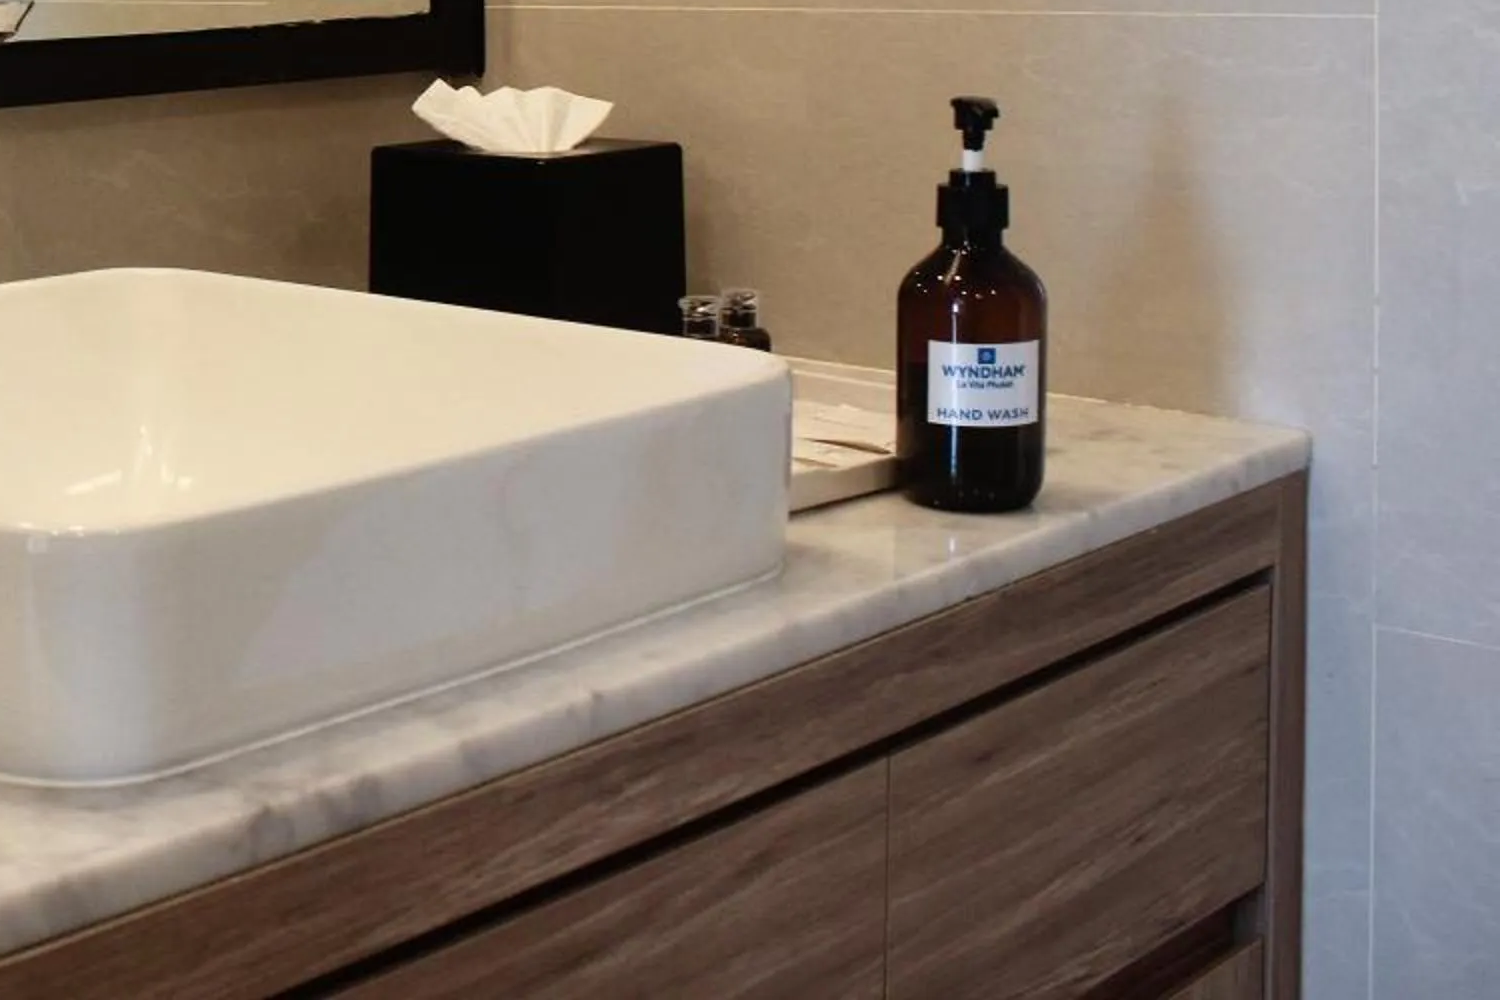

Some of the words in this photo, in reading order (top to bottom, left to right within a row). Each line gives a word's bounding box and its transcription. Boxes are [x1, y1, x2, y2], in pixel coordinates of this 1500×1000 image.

[941, 364, 1026, 379] WYNDHAM
[936, 407, 982, 421] HAND
[987, 407, 1029, 420] WASH
